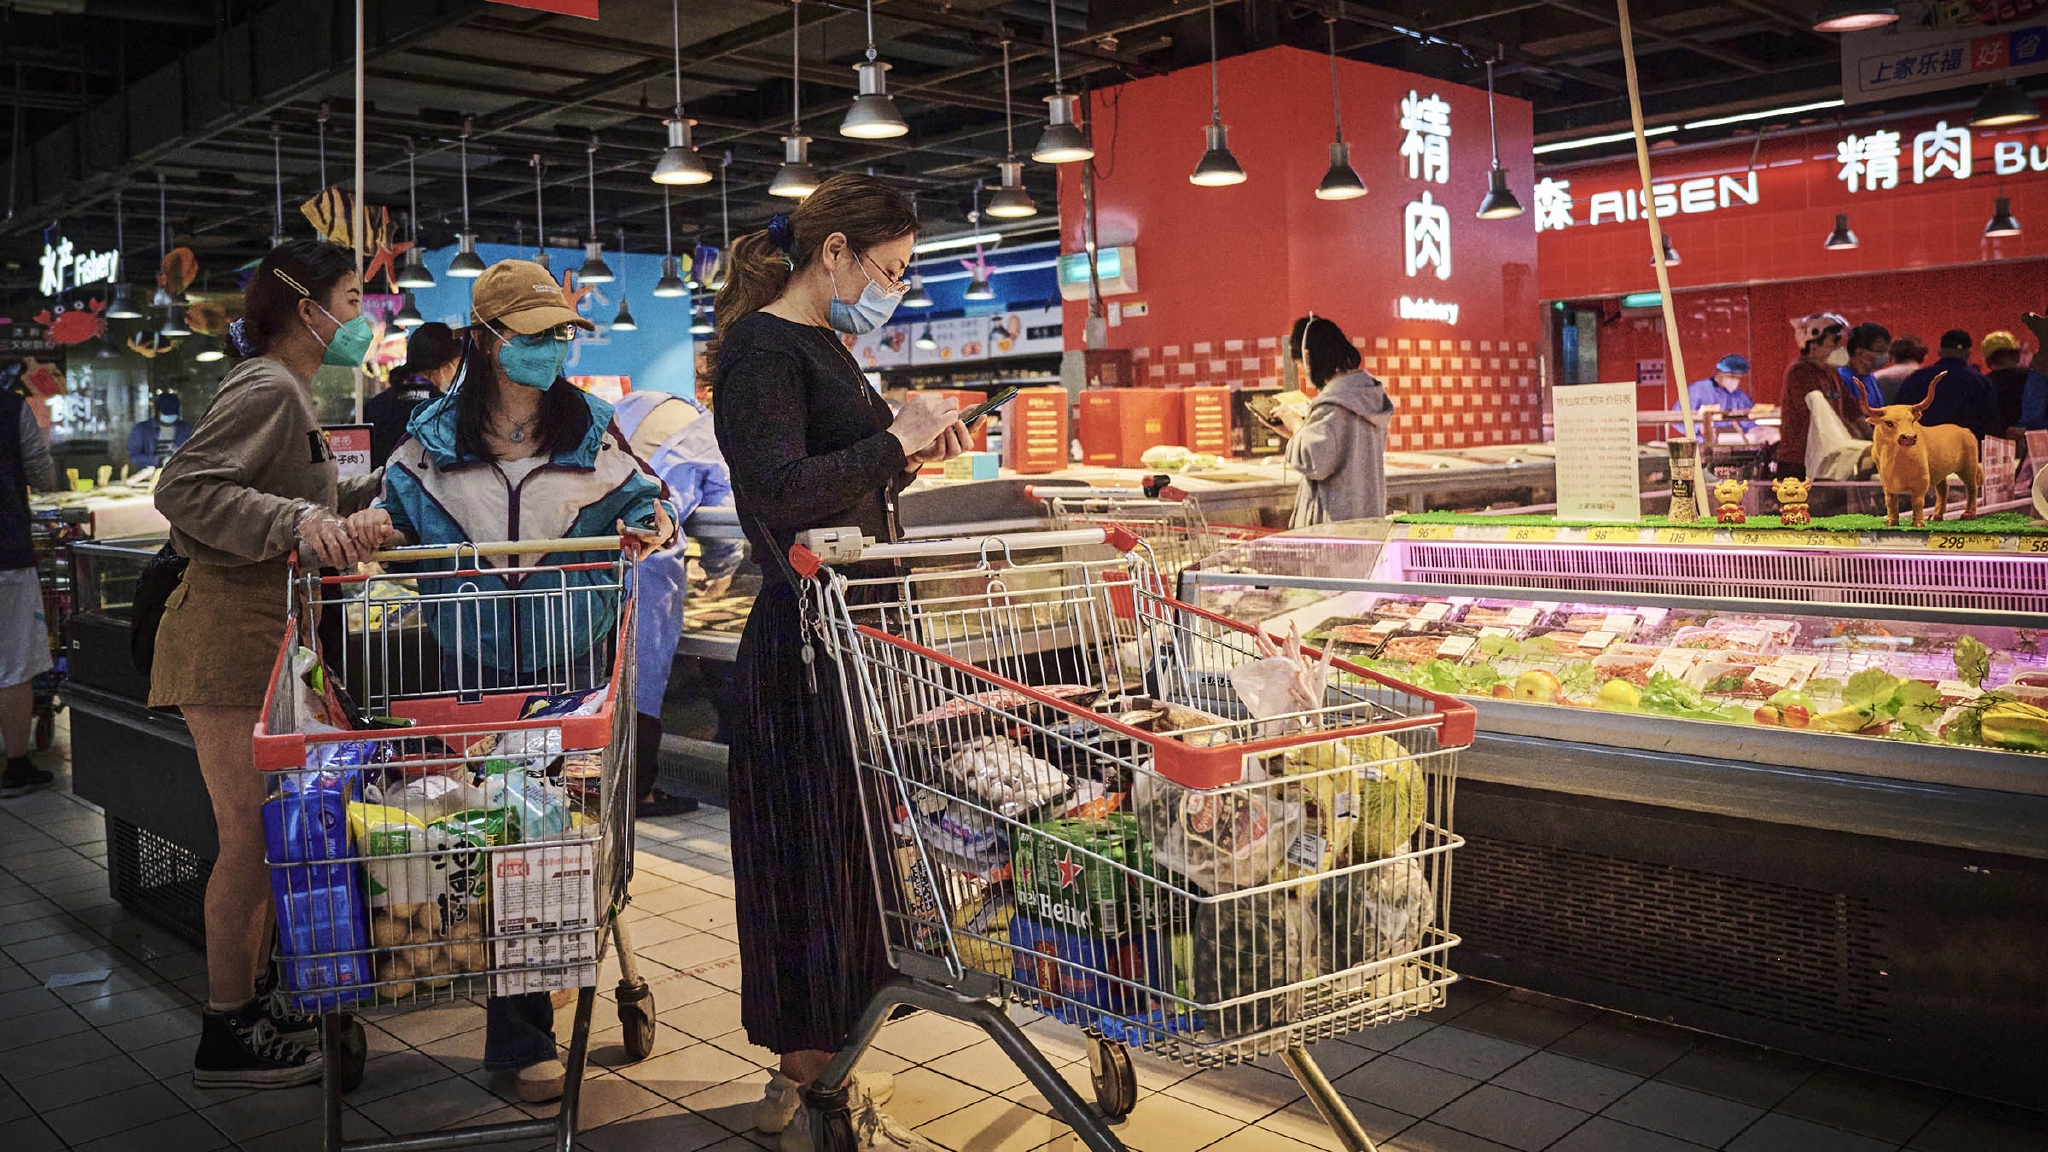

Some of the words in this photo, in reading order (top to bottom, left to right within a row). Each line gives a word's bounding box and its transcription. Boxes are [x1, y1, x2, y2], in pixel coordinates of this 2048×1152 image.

[1870, 48, 1963, 84] 上家乐福
[1837, 120, 1971, 194] 精肉
[1994, 141, 2048, 176] Bu
[1400, 90, 1451, 280] 精肉
[1590, 170, 1759, 226] AISEN
[75, 248, 119, 288] Fishery
[1515, 530, 1530, 540] 88
[1594, 531, 1608, 541] 98
[1938, 536, 1965, 549] 298
